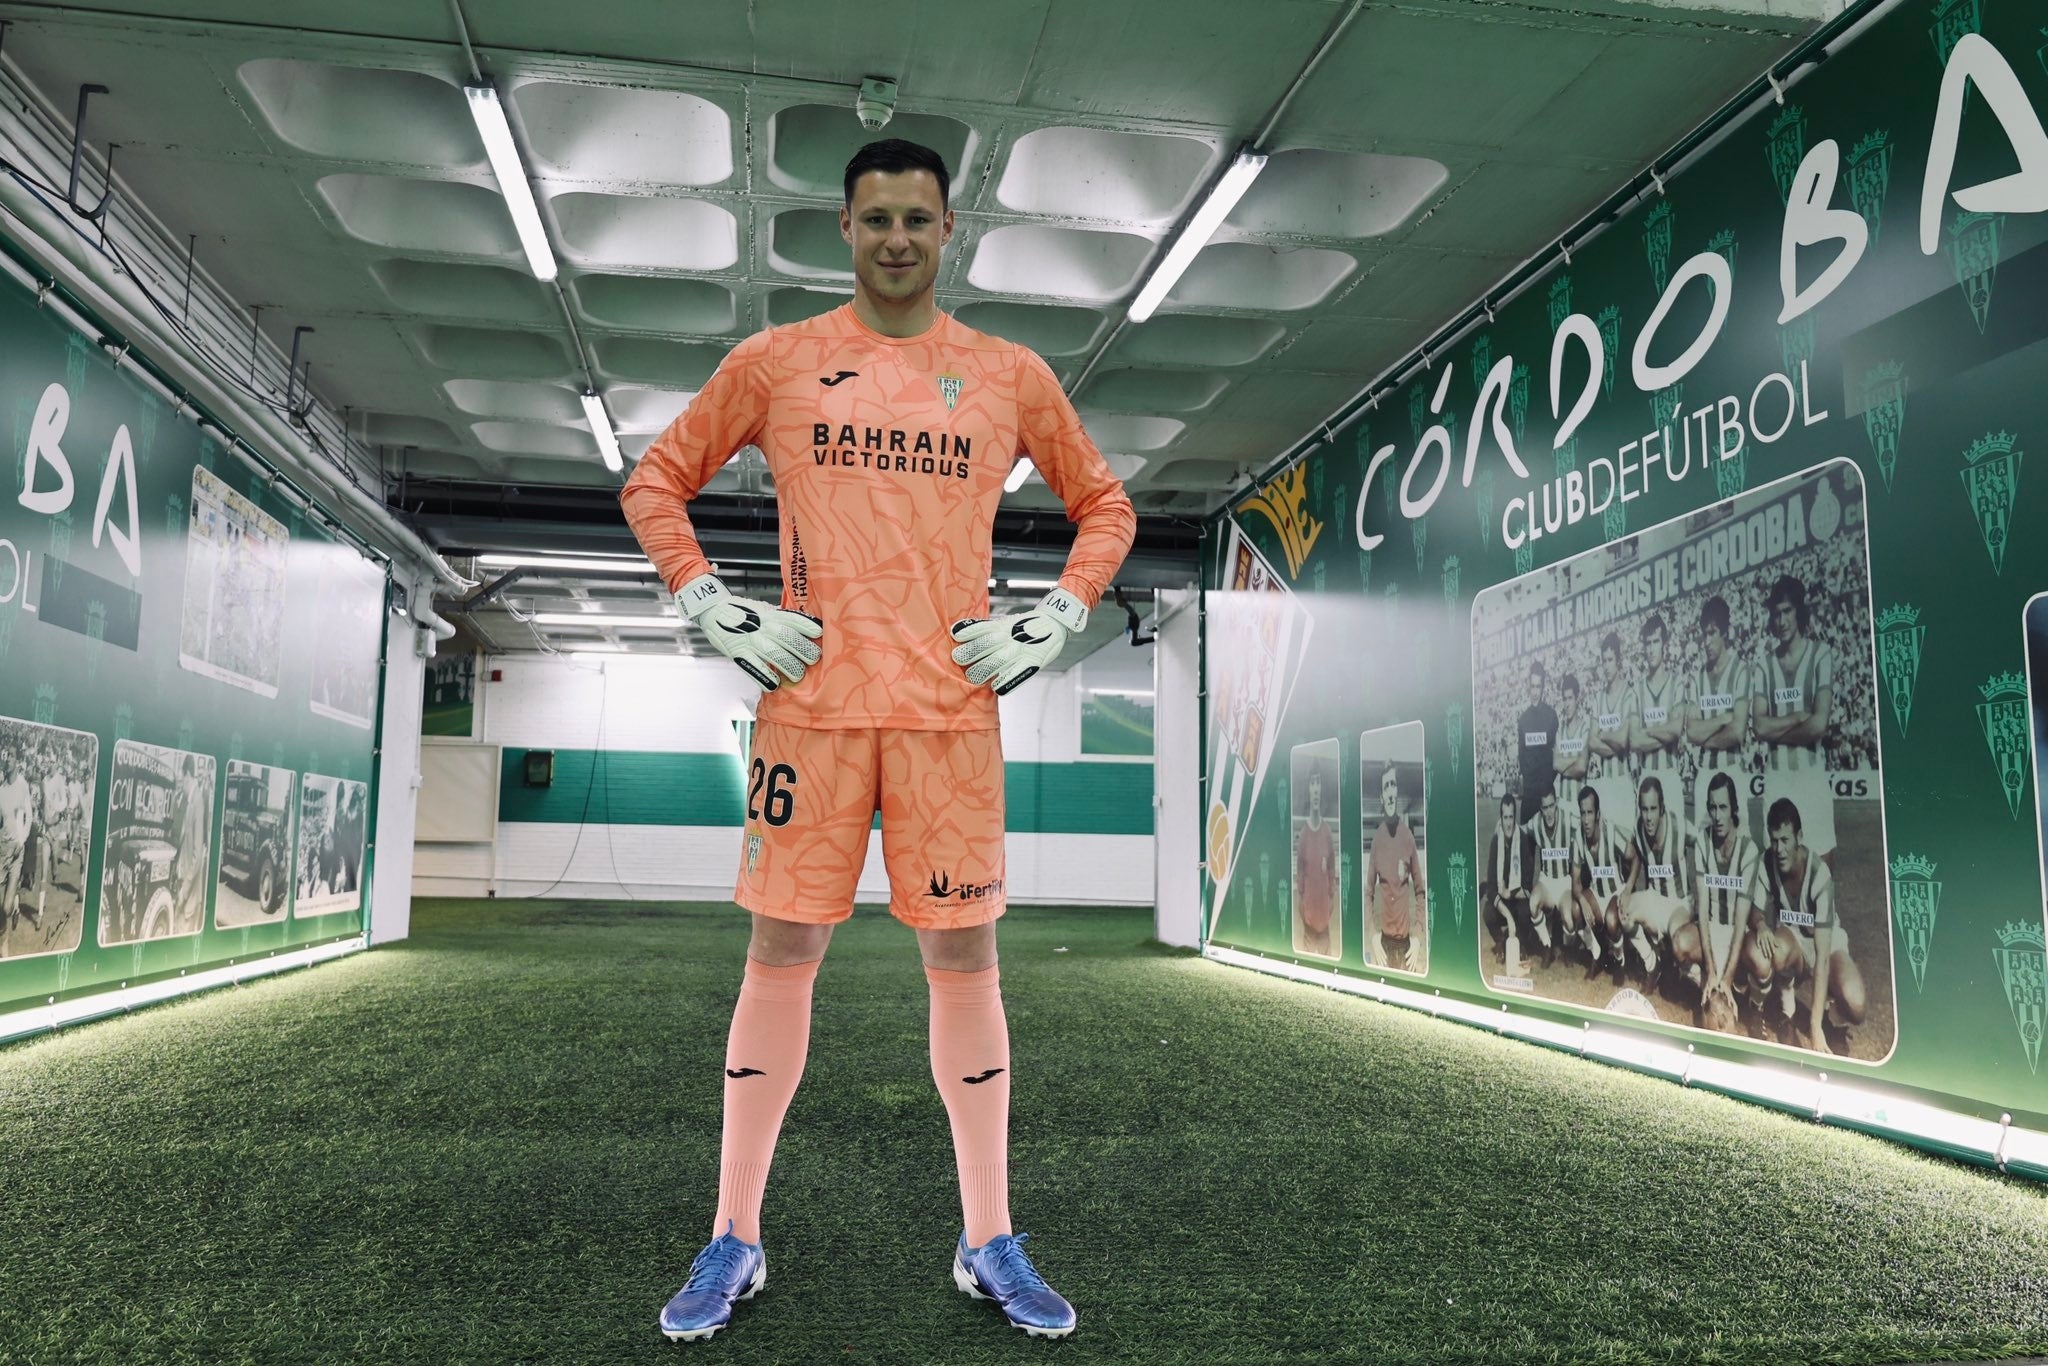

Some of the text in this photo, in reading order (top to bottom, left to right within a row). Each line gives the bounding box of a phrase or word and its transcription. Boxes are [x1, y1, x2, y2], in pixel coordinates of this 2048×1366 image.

[814, 423, 971, 459] BAHRAIN
[814, 449, 969, 479] VICTORIOUS
[1557, 601, 1574, 640] DE
[1575, 565, 1651, 630] AHORROS
[1655, 552, 1679, 602] DE
[1681, 493, 1807, 591] CORDOBA
[1775, 688, 1798, 701] VARO
[1701, 696, 1732, 709] URBANO
[1644, 710, 1666, 720] SALAS
[748, 757, 797, 827] 26
[1542, 848, 1569, 858] MARTINEZ
[1592, 867, 1614, 877] JUAREZ
[1649, 866, 1673, 876] ONEGA
[1705, 875, 1743, 888] BURGUETE
[1781, 911, 1814, 925] RIVERO
